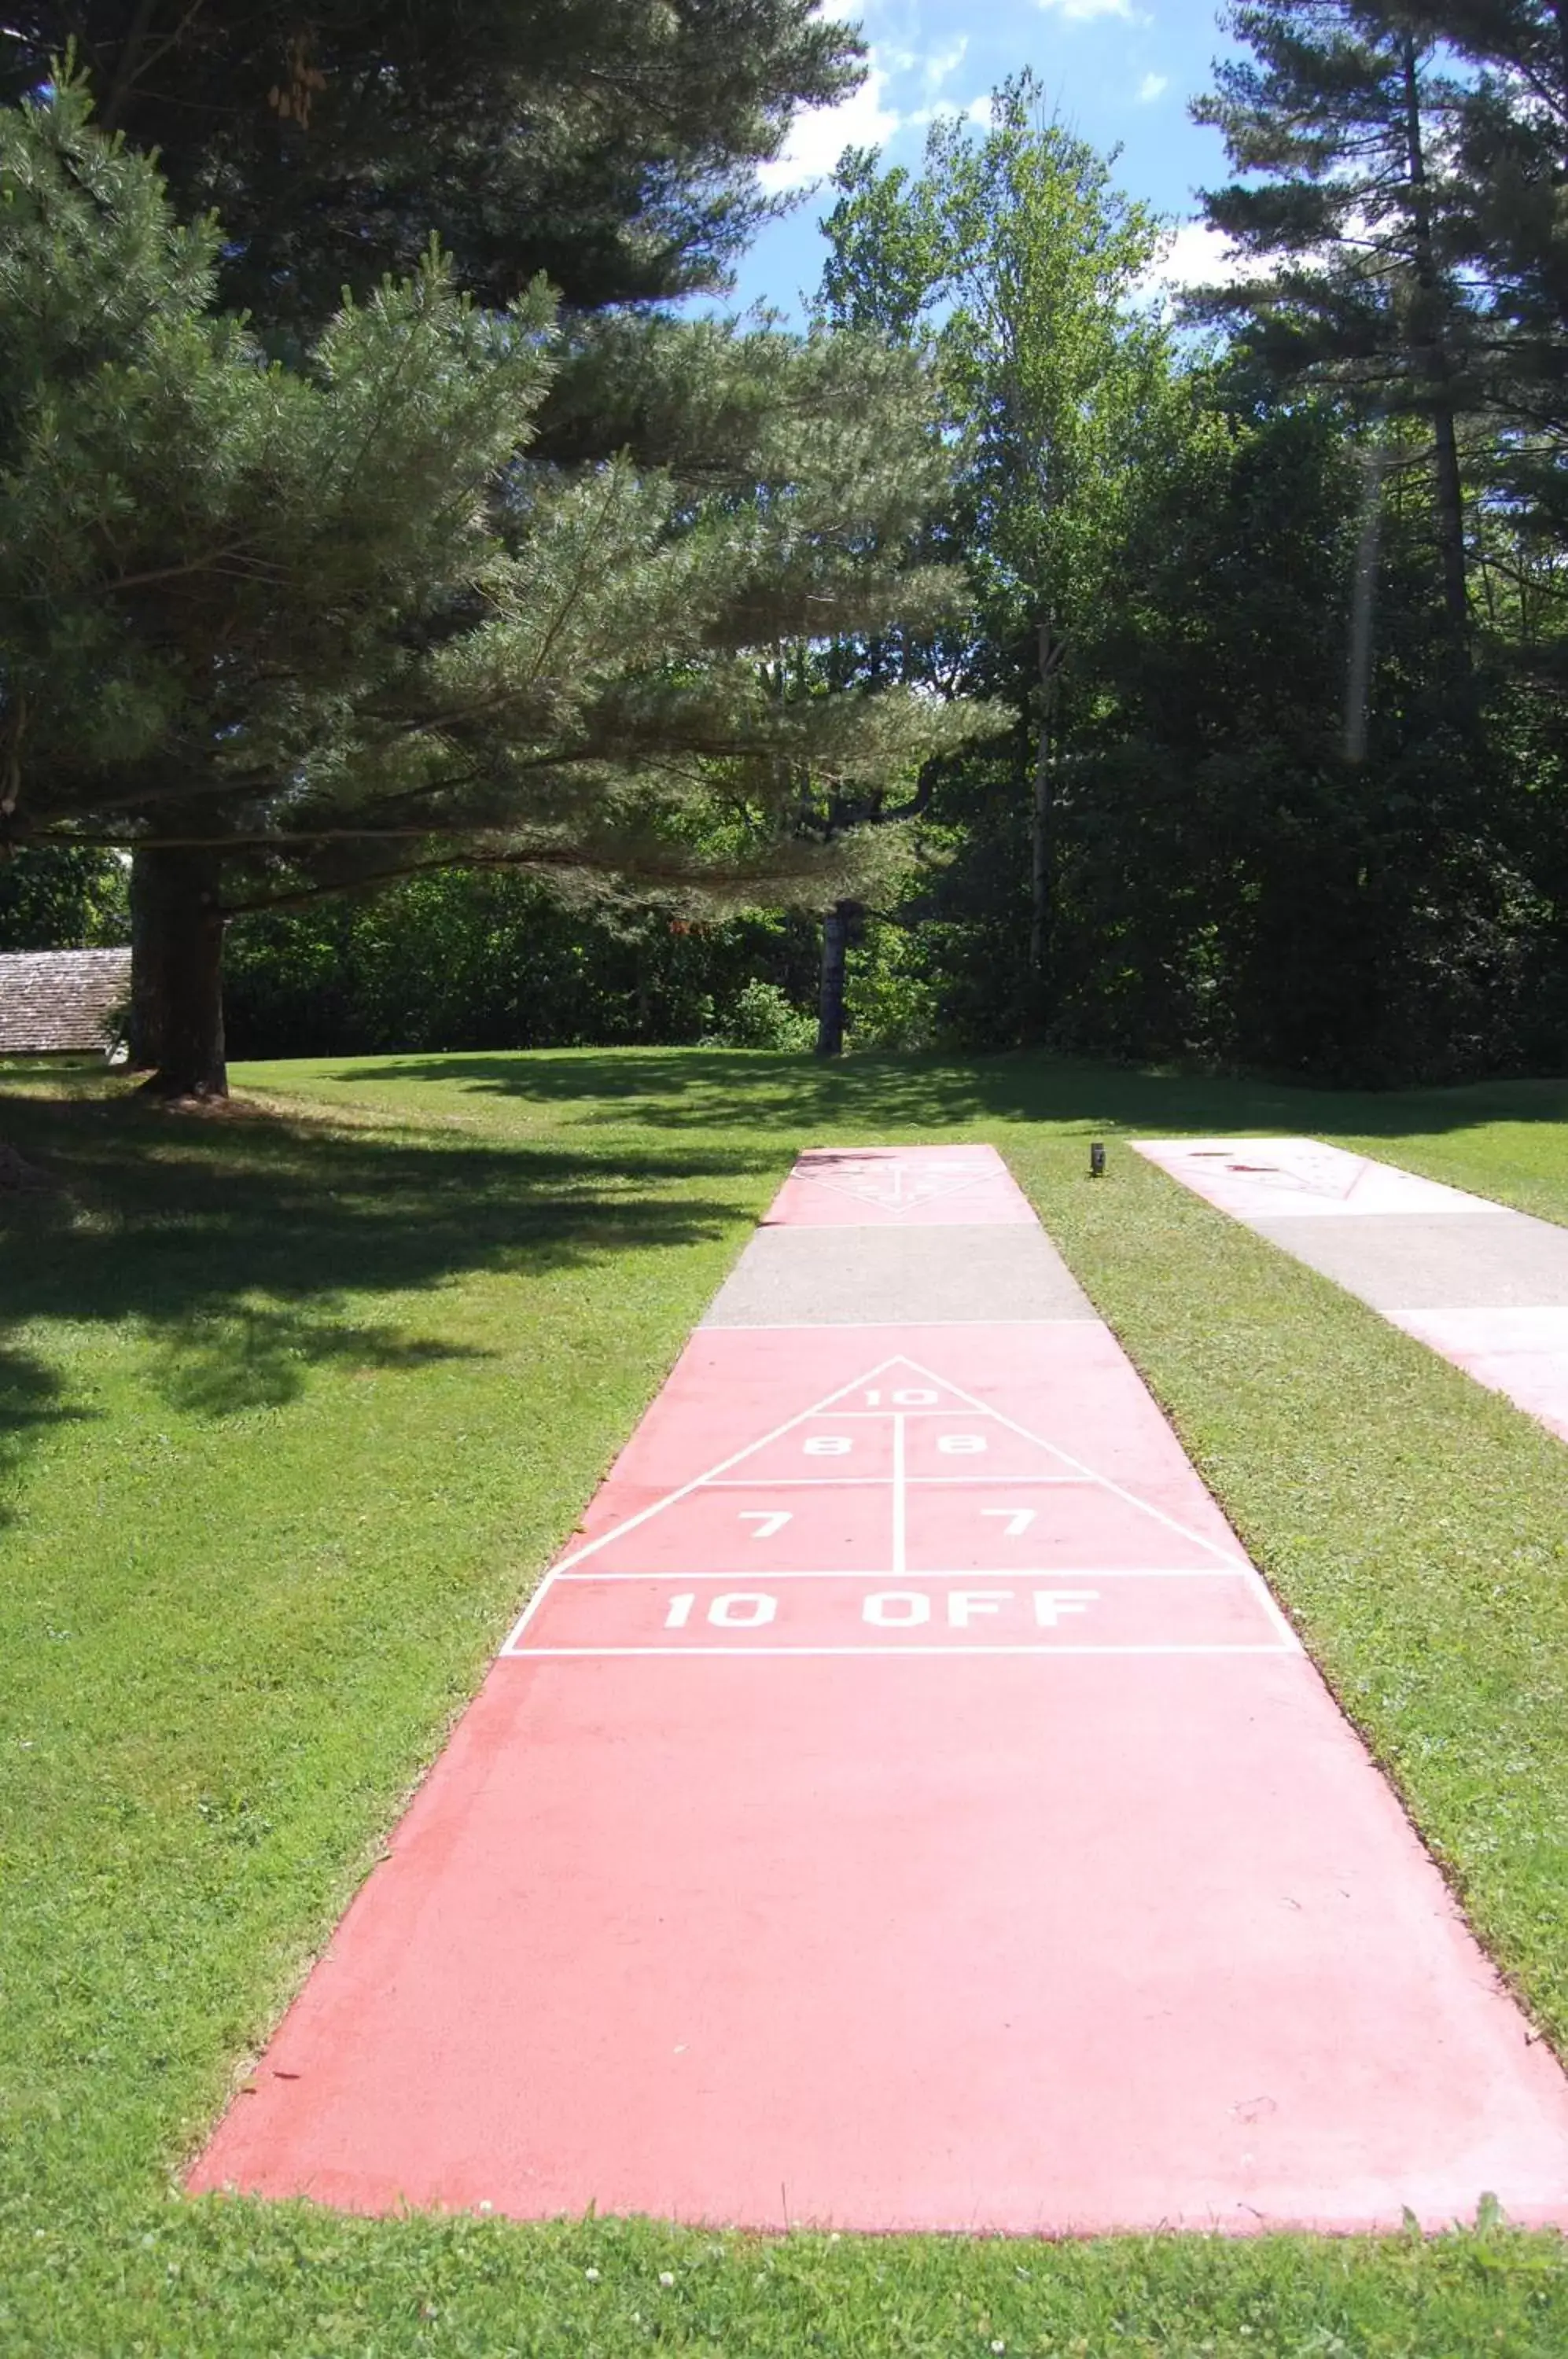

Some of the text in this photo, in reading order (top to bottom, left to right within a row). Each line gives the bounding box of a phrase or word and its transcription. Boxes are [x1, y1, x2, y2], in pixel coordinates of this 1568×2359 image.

[865, 1389, 938, 1406] 10
[803, 1437, 853, 1455] 8
[937, 1435, 988, 1454] 8
[738, 1511, 793, 1538] 7
[981, 1509, 1036, 1536] 7
[664, 1590, 1100, 1628] 10 OFF
